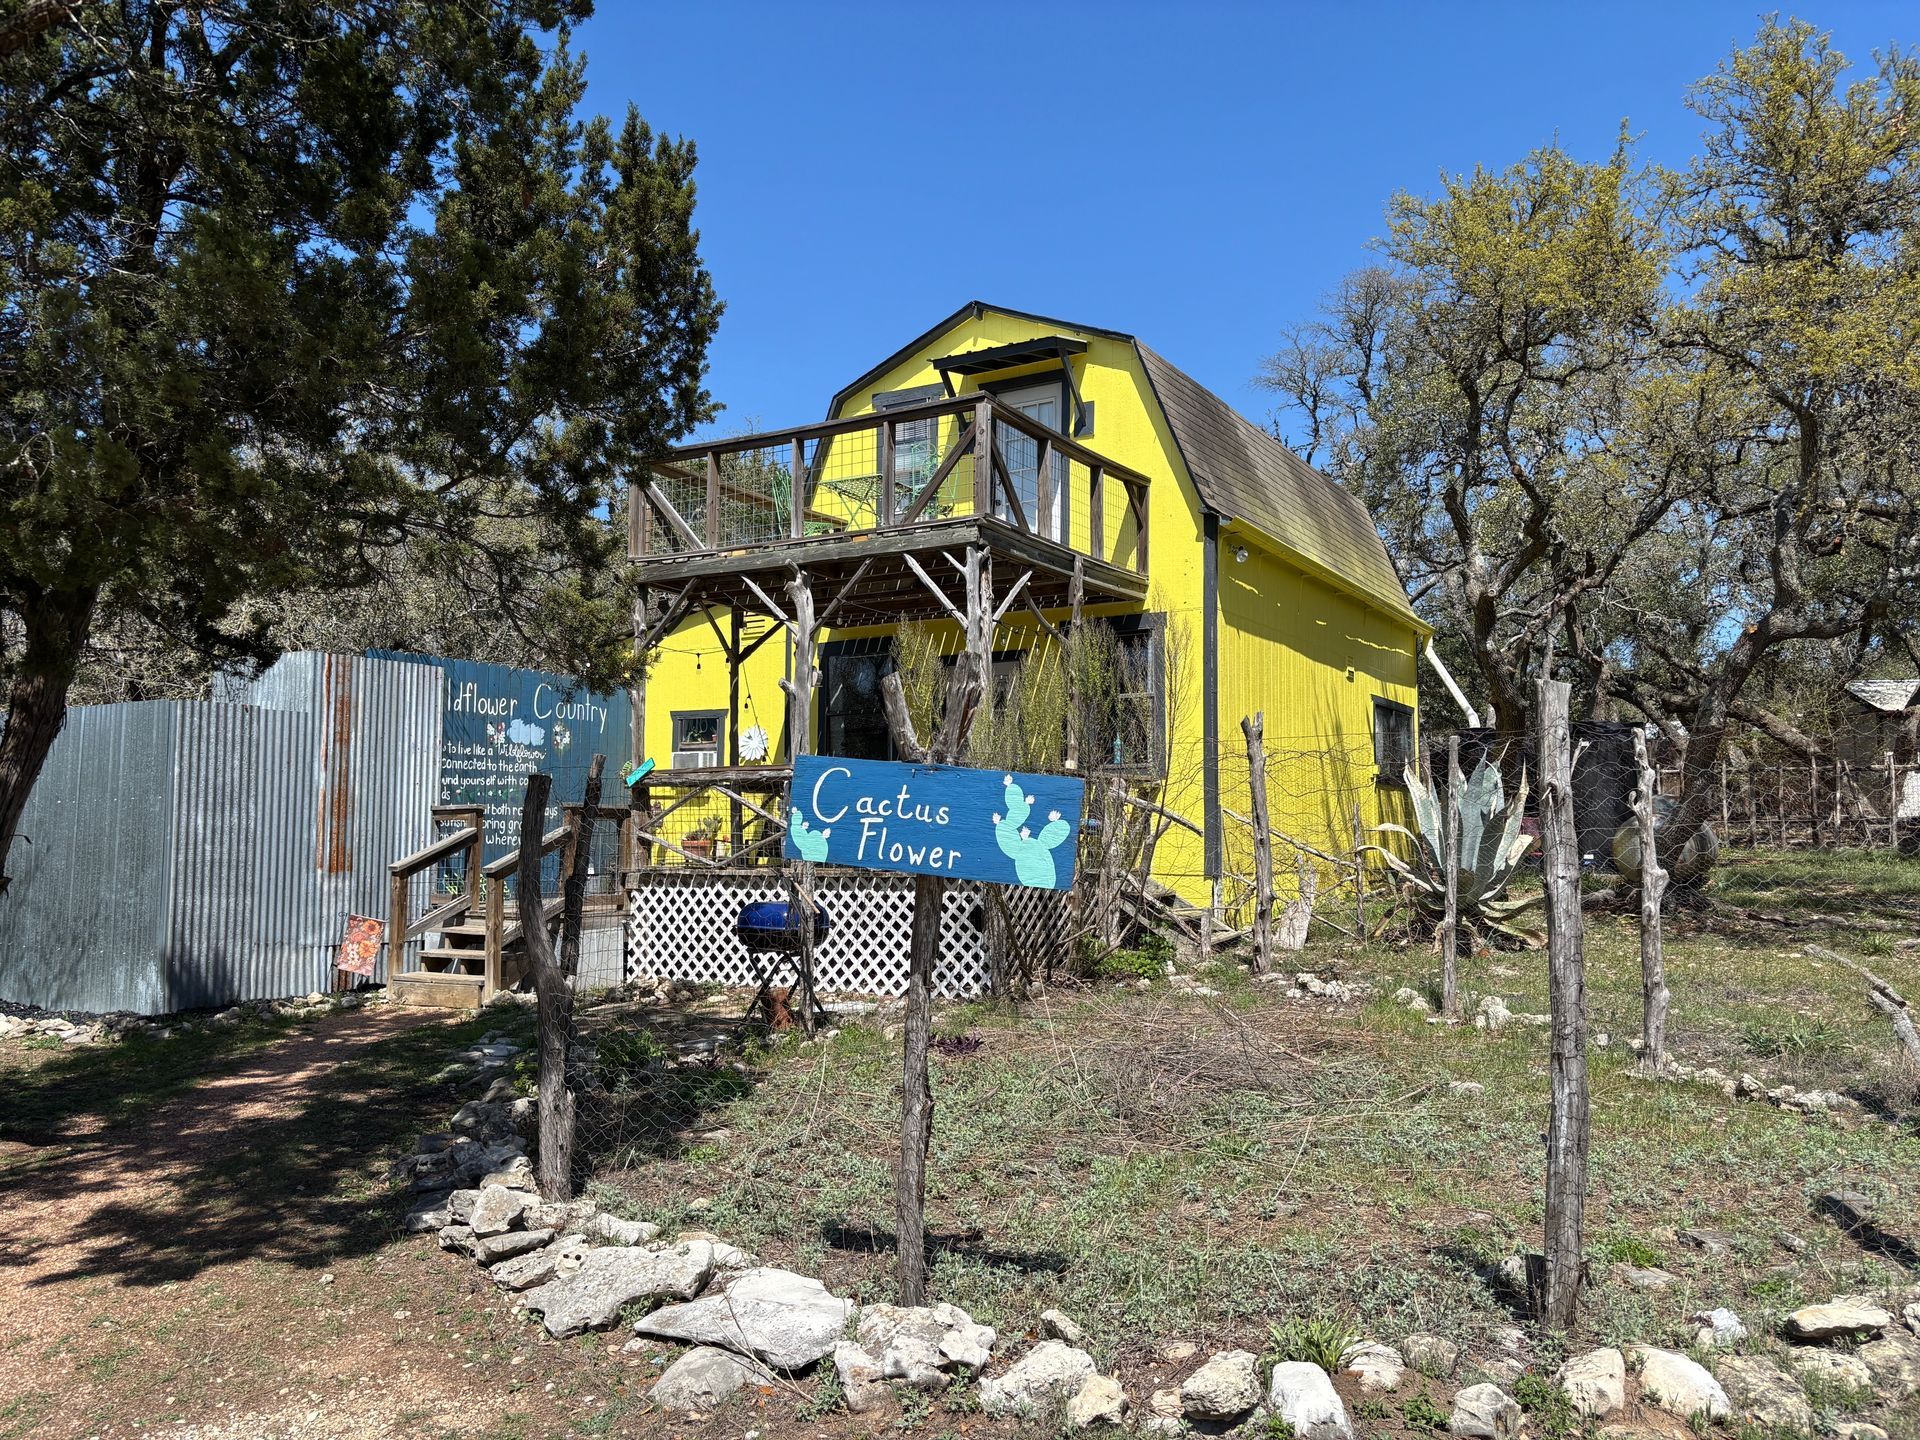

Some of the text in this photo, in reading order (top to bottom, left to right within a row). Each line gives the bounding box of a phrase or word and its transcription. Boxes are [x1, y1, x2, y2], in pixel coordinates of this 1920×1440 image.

[447, 677, 608, 734] ldflower Country
[447, 741, 457, 754] to
[458, 741, 472, 755] live
[473, 744, 486, 756] like
[488, 748, 494, 756] a
[487, 758, 497, 771] to
[498, 759, 514, 772] the
[514, 761, 537, 772] earth
[442, 774, 458, 785] und
[497, 775, 517, 786] with
[812, 767, 950, 825] Cactus
[491, 803, 511, 815] both
[545, 807, 558, 818] ays
[857, 818, 962, 870] Flower
